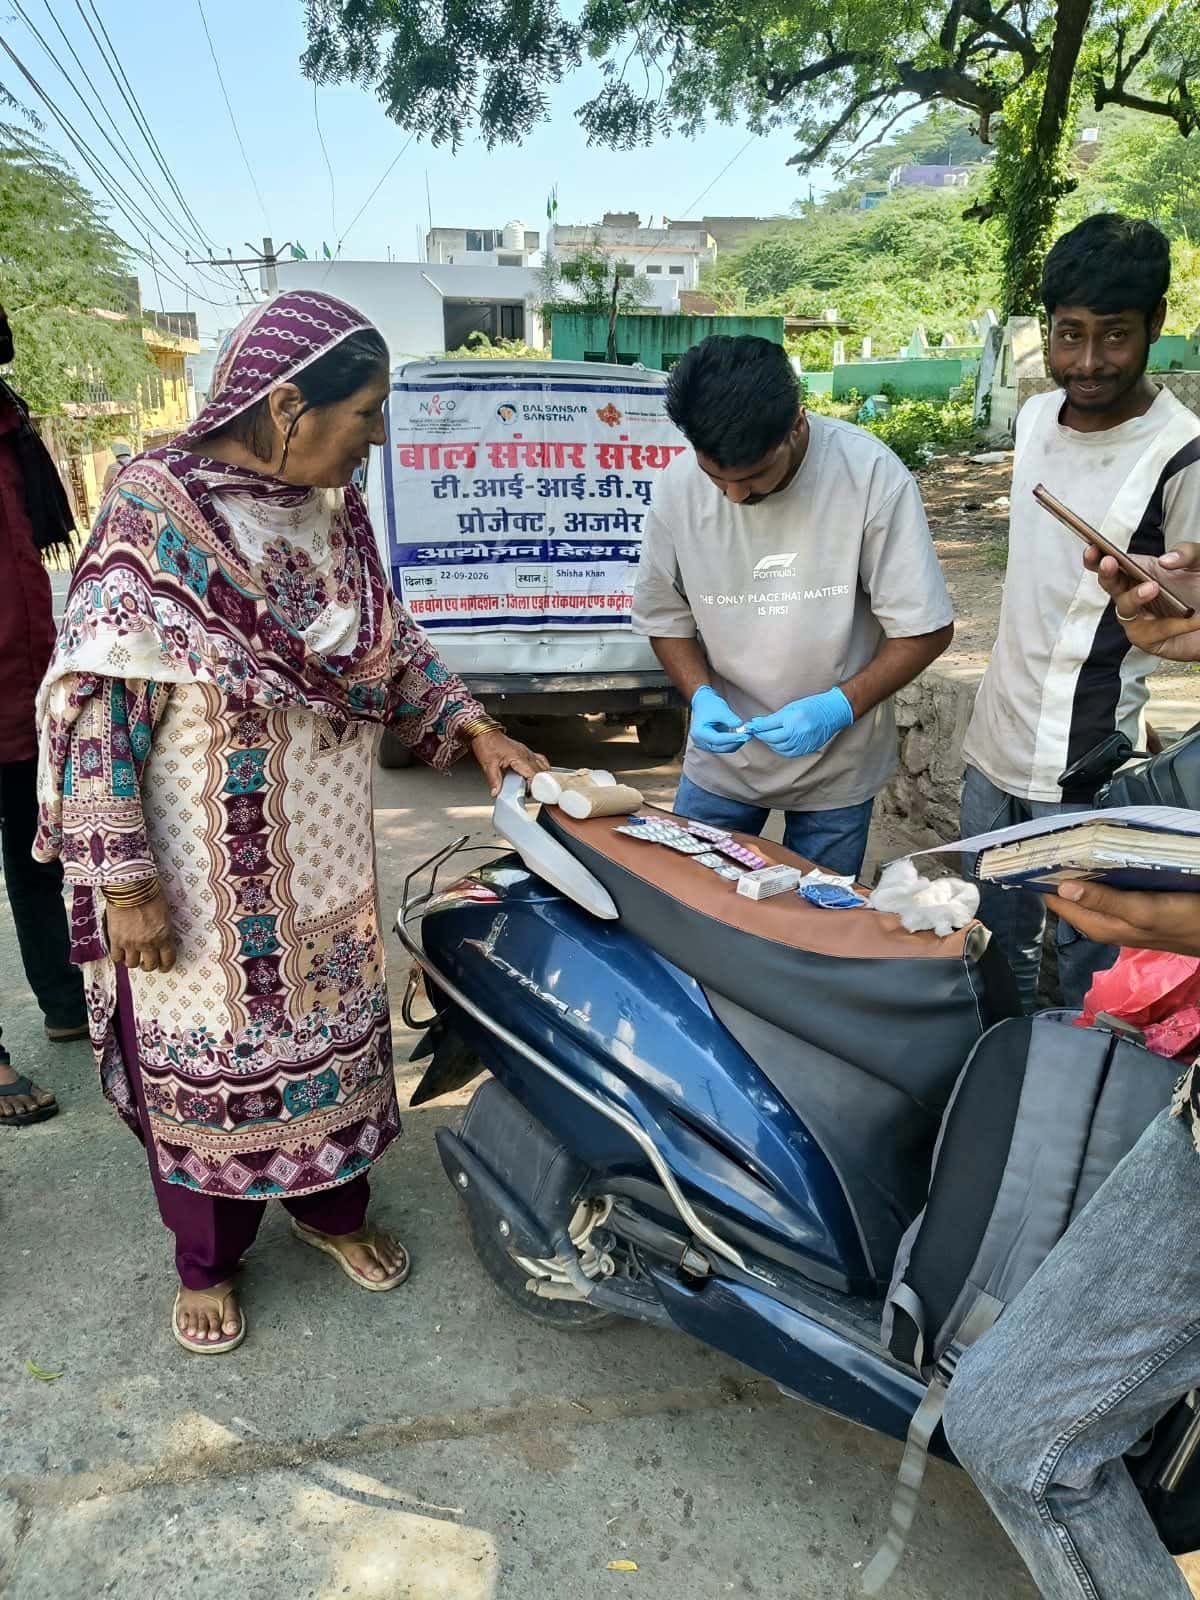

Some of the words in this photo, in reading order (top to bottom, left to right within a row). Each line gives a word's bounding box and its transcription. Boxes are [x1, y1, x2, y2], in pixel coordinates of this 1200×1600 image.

[522, 404, 543, 413] BAL
[545, 404, 587, 414] SANSAR
[524, 413, 574, 422] SANSTHA
[397, 442, 480, 470] बाल
[486, 433, 587, 469] संसार
[457, 507, 555, 536] प्रोजेक्ट,
[564, 507, 644, 533] अजमेर
[417, 543, 542, 559] आयोजन
[440, 571, 489, 581] 22-09-2026
[556, 569, 583, 578] Shisha
[585, 570, 605, 578] Khan
[700, 594, 714, 605] HE
[717, 594, 744, 605] ONLY
[748, 592, 779, 603] PLACE
[781, 592, 801, 602] THAT
[804, 585, 849, 600] MATTERS
[758, 606, 766, 616] IS
[769, 606, 789, 616] FIRST
